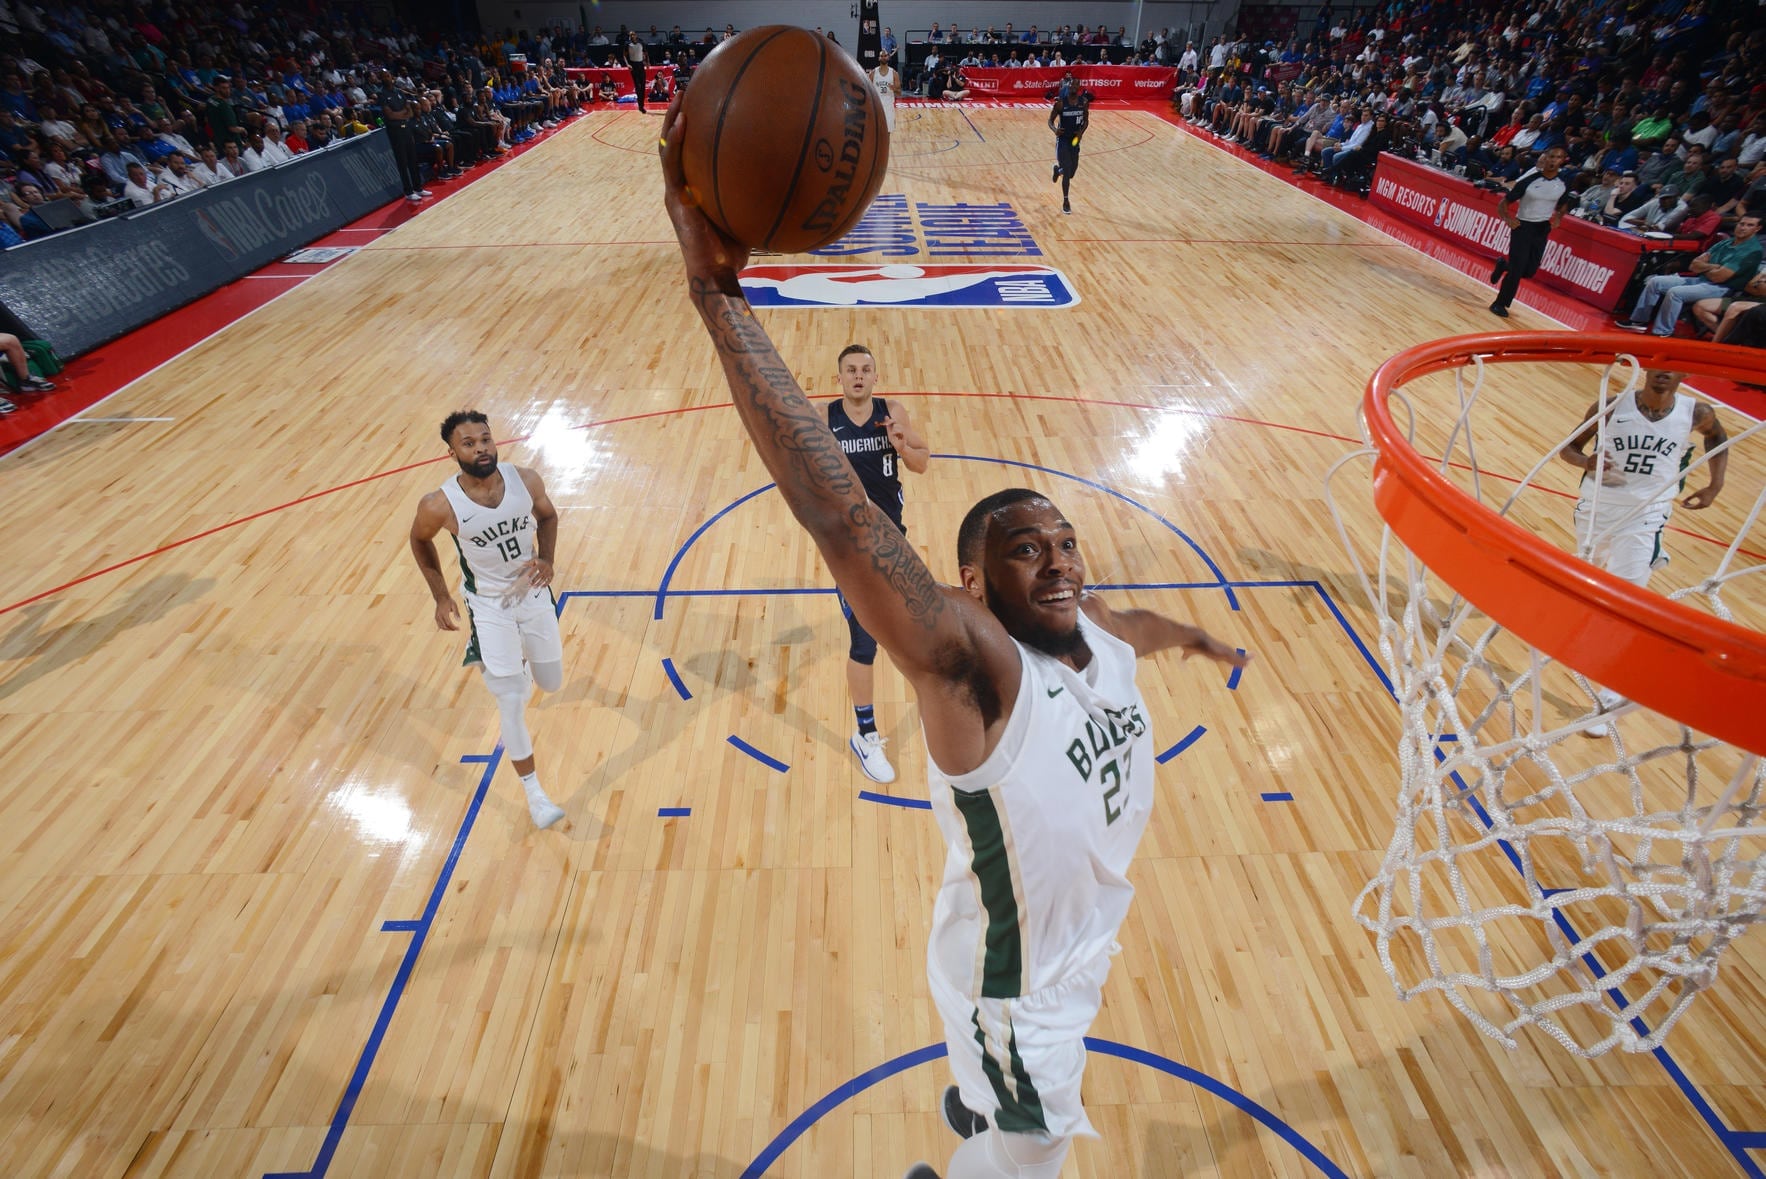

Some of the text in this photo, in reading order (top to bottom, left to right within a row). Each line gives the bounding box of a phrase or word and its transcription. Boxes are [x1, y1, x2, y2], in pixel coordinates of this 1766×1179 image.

[967, 81, 997, 89] ANINI
[1089, 79, 1123, 87] TISSOT
[1134, 79, 1164, 87] verizon
[802, 78, 867, 234] SPALDING
[1376, 177, 1512, 255] MGM RESORTS SUMMER LEAG
[916, 203, 1043, 256] LEAGUE
[994, 280, 1055, 302] NBA
[838, 434, 894, 454] AVERICK
[1613, 435, 1677, 456] BUCKS
[882, 453, 893, 477] 8
[1623, 453, 1657, 475] 55
[470, 515, 529, 548] BUCKS
[496, 536, 522, 562] 19
